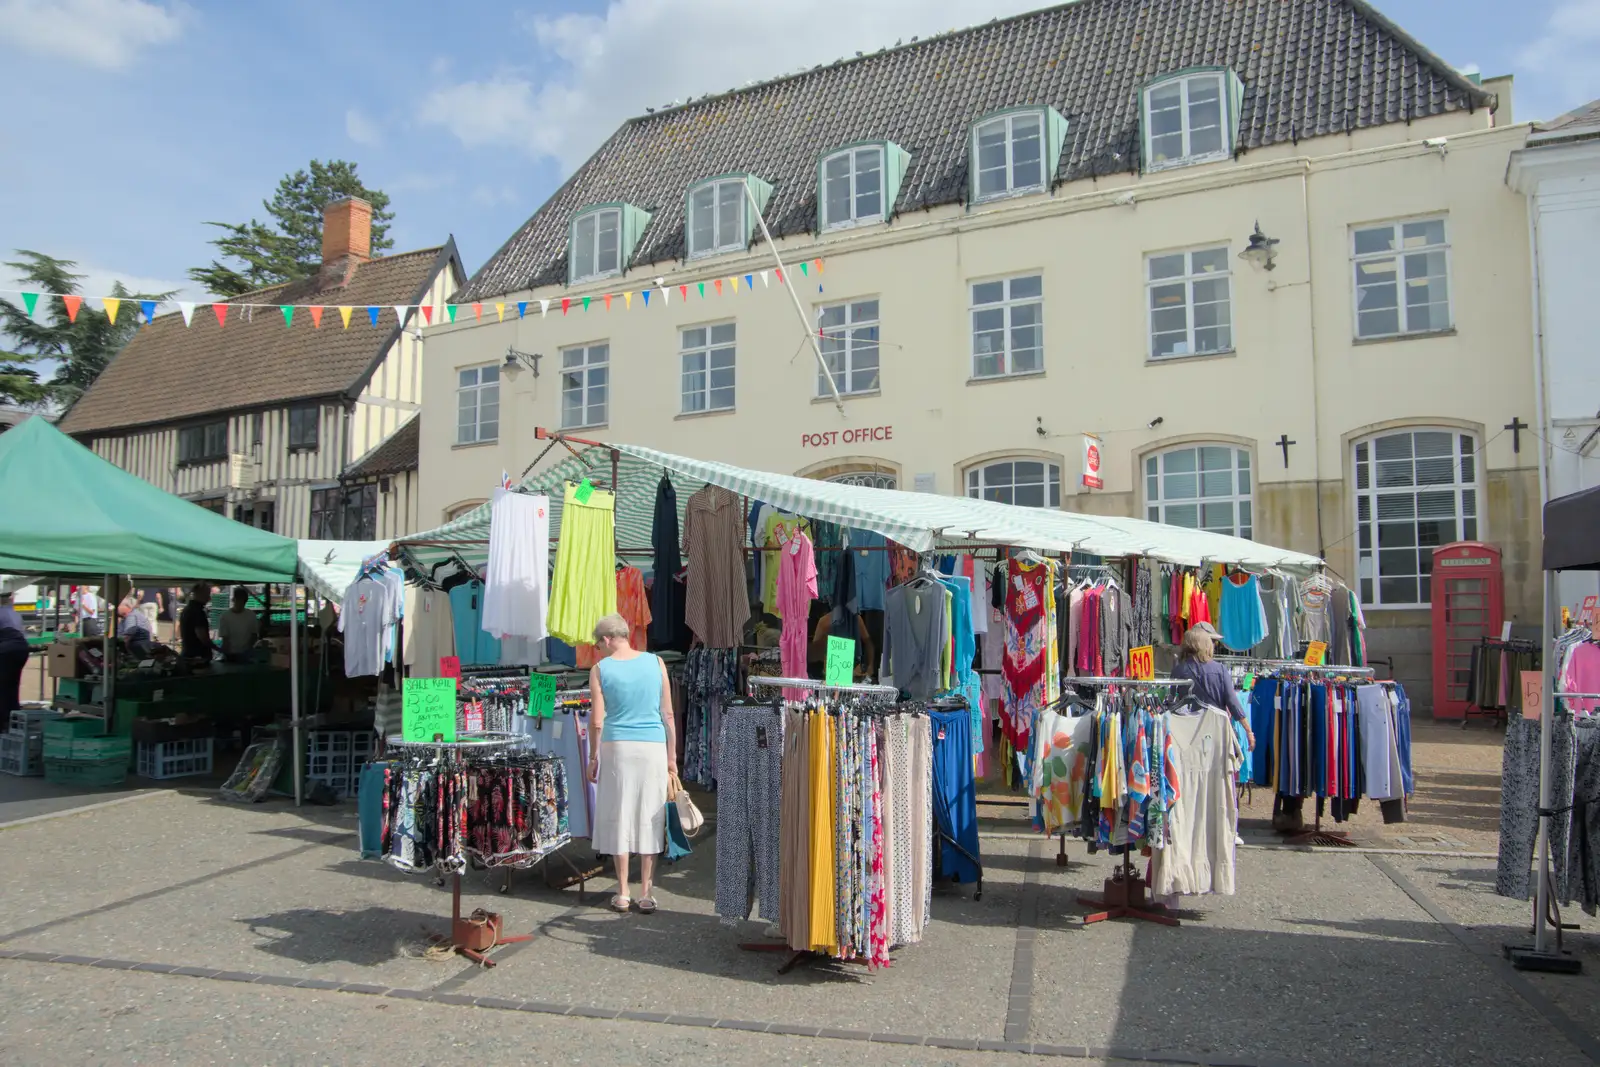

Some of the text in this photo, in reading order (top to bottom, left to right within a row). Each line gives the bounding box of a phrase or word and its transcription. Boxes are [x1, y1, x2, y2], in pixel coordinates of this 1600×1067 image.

[802, 425, 893, 447] POST OFFICE
[831, 640, 848, 650] SALE
[1132, 651, 1151, 678] £10
[406, 678, 452, 690] SALE RAIL
